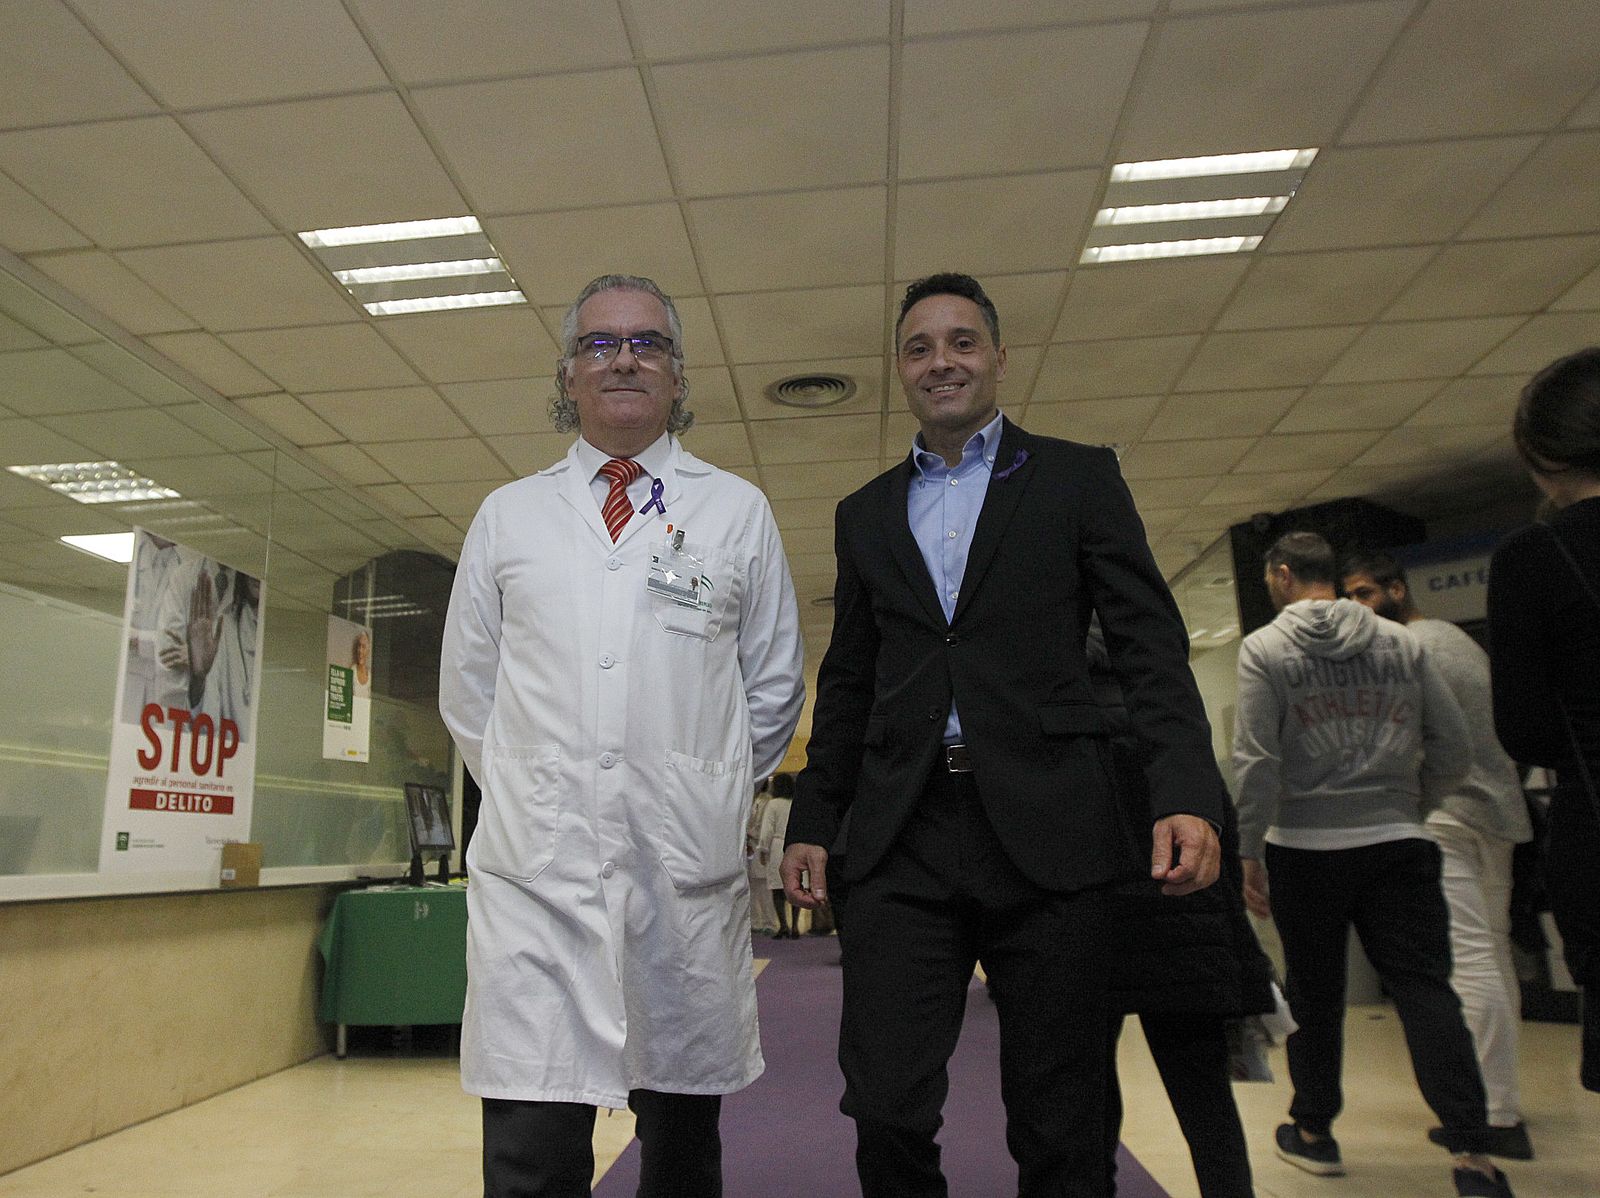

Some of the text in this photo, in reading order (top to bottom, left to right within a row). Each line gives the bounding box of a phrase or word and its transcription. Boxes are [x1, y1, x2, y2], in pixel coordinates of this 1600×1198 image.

[1282, 649, 1418, 688] ORIGINAL
[1292, 688, 1412, 729] ATHLETIC
[137, 703, 239, 777] STOP
[133, 775, 159, 787] agredir
[169, 778, 197, 789] personal
[155, 792, 213, 812] DELITO
